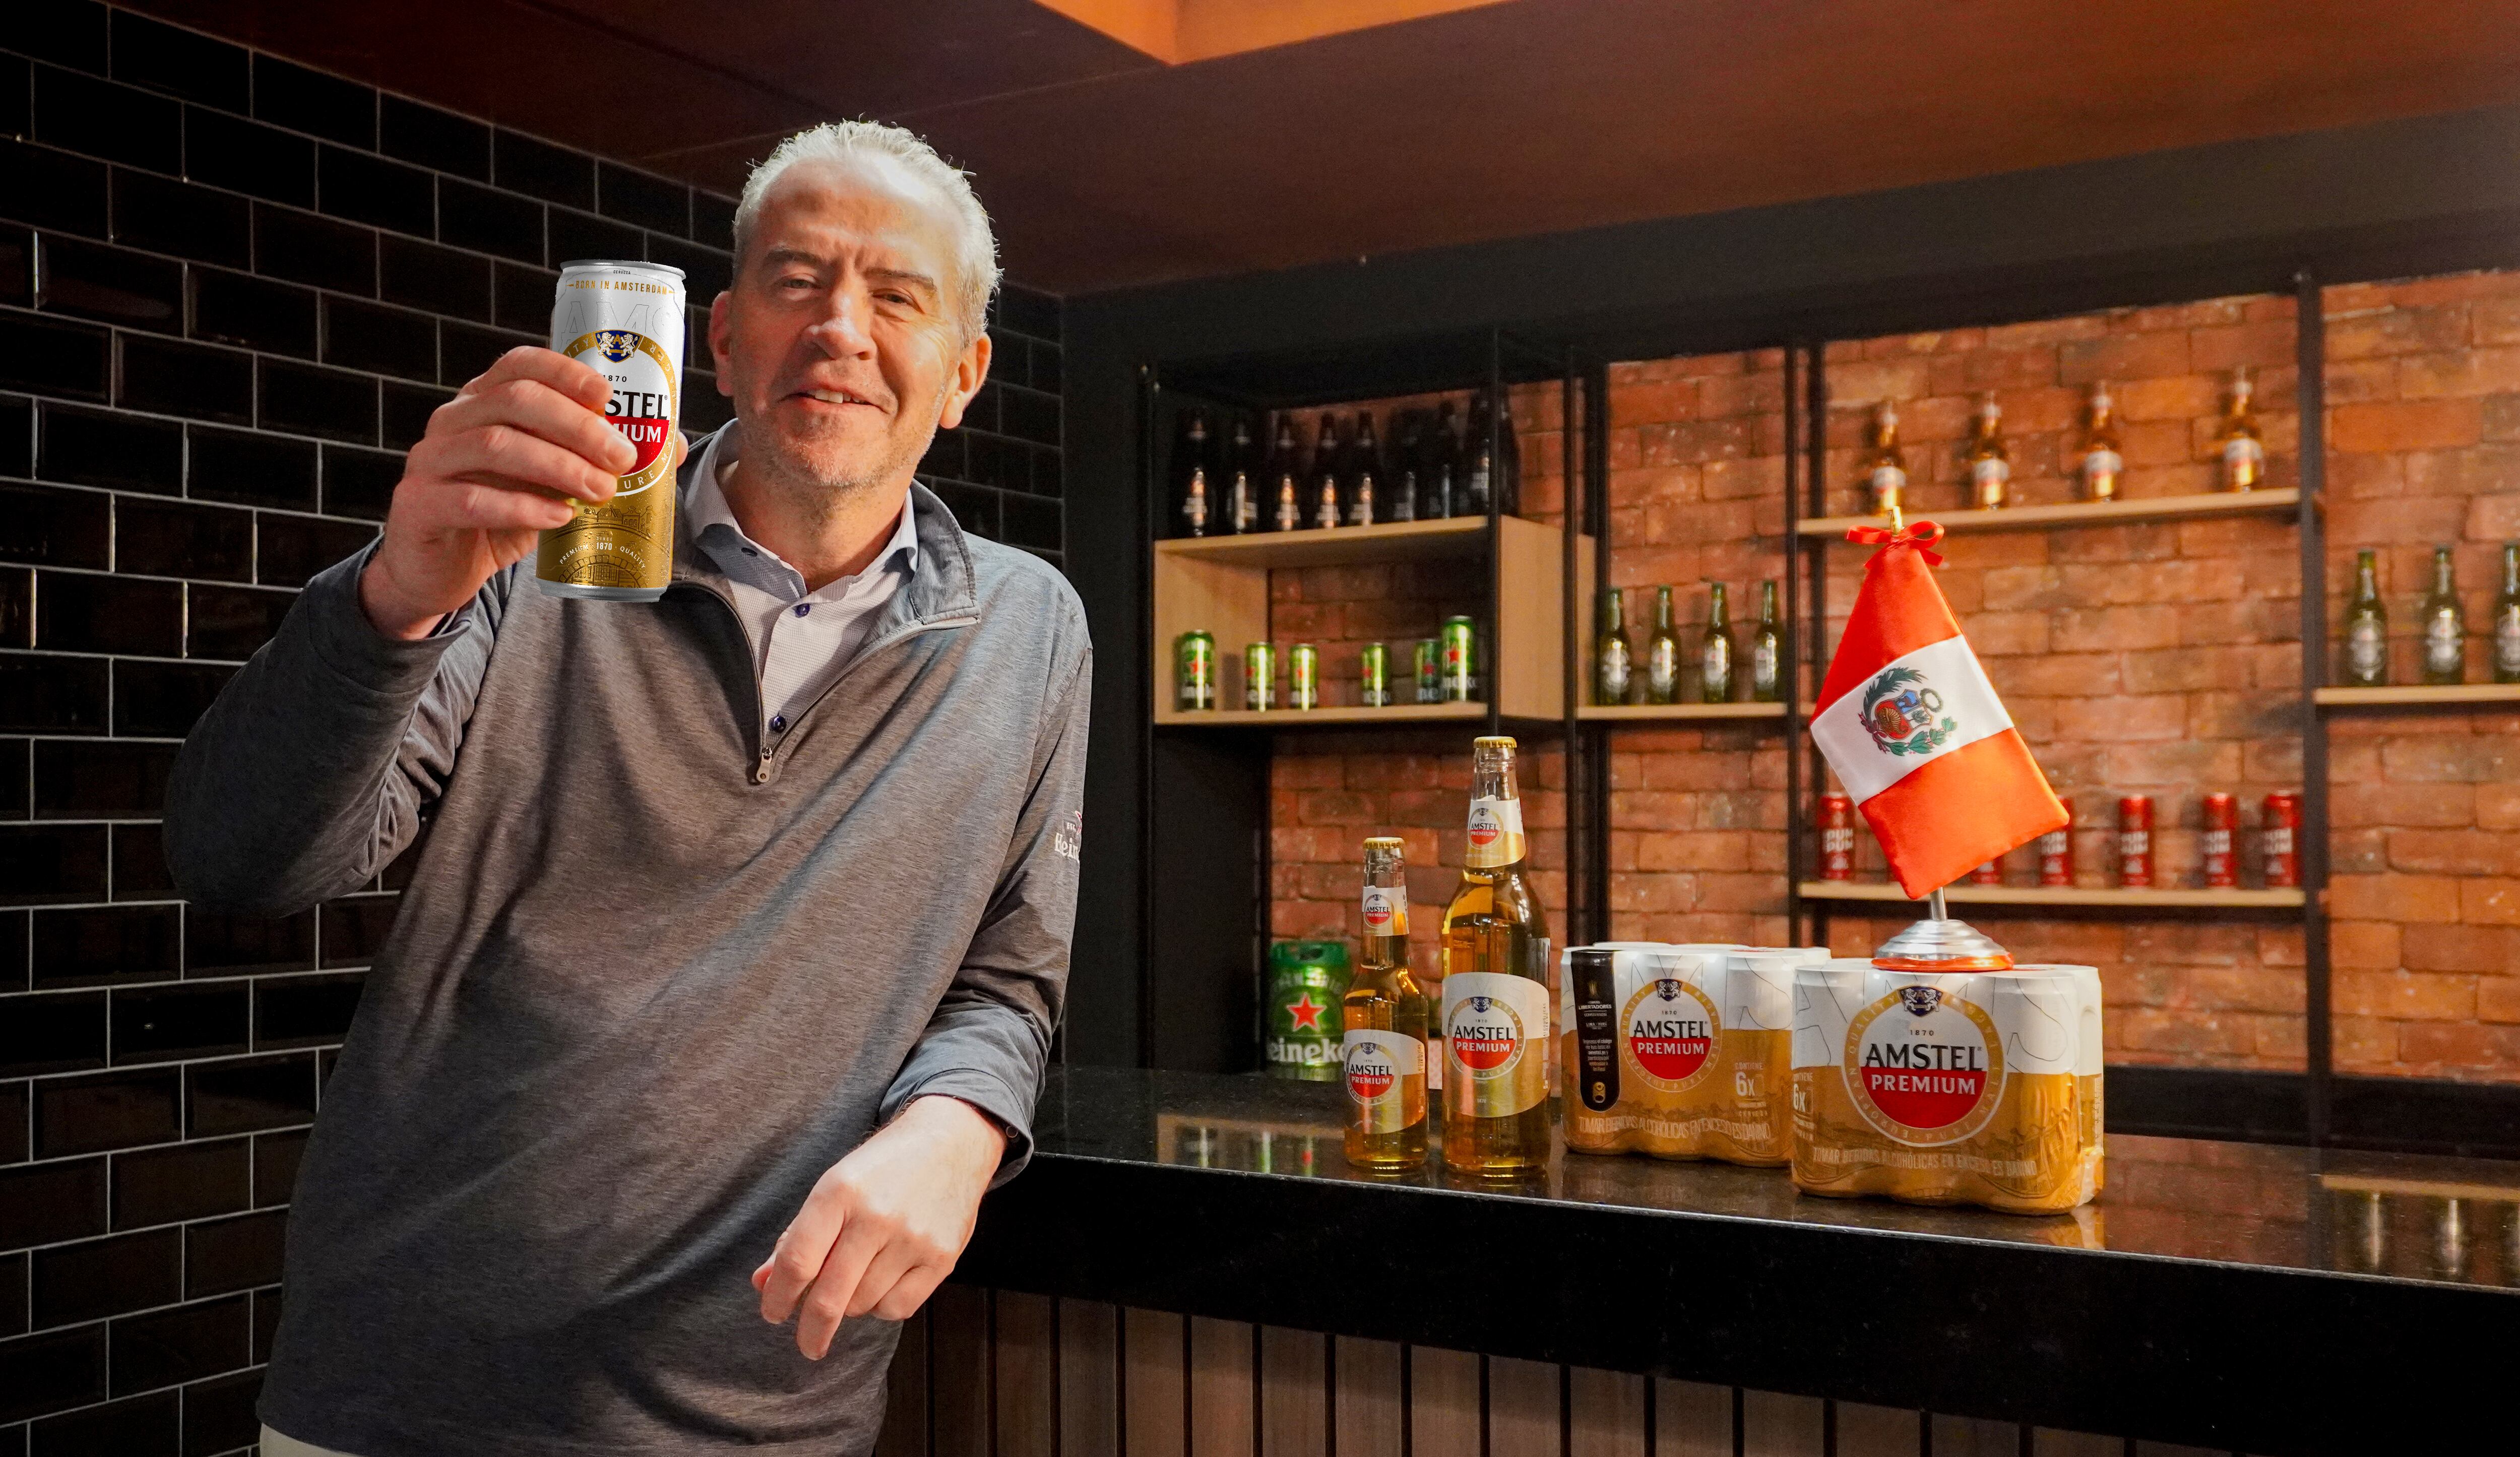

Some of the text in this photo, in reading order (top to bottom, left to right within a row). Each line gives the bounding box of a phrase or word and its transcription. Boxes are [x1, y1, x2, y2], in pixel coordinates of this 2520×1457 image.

[576, 280, 667, 295] BORN IN AMSTERDAM
[605, 390, 668, 420] STEL
[559, 542, 646, 569] PREMIUM 1870 QUALITY
[1471, 822, 1498, 831] AMSTEL
[1054, 832, 1080, 863] Hein
[1454, 1025, 1514, 1041] AMSTEL
[1633, 1020, 1709, 1039] AMSTEL
[1456, 1041, 1510, 1052] PREMIUM
[1637, 1042, 1705, 1055] PREMIUM
[1865, 1043, 1983, 1072] AMSTEL
[1350, 1064, 1393, 1076] AMSTEL
[1351, 1076, 1390, 1085] PREMIUM
[1870, 1074, 1976, 1095] PREMIUM
